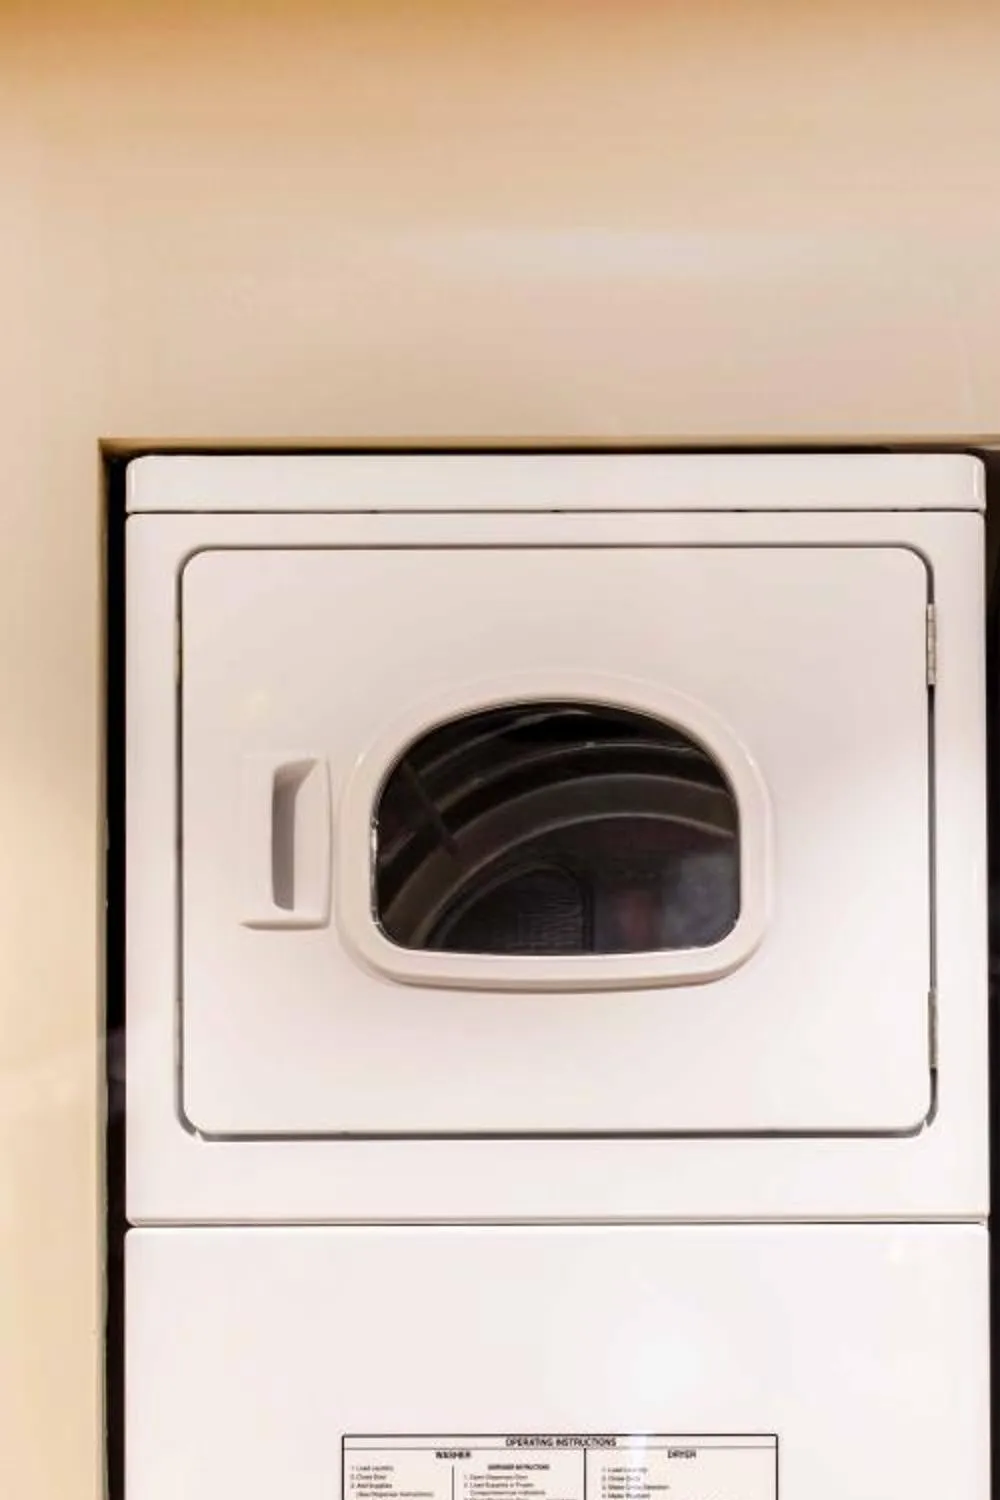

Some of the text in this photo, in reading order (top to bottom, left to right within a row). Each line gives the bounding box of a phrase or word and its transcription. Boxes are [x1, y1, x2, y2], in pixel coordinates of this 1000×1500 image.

[505, 1438, 617, 1448] OPERATING INSTRUCTIONS
[435, 1451, 471, 1459] WASHER
[667, 1450, 697, 1459] DRYER
